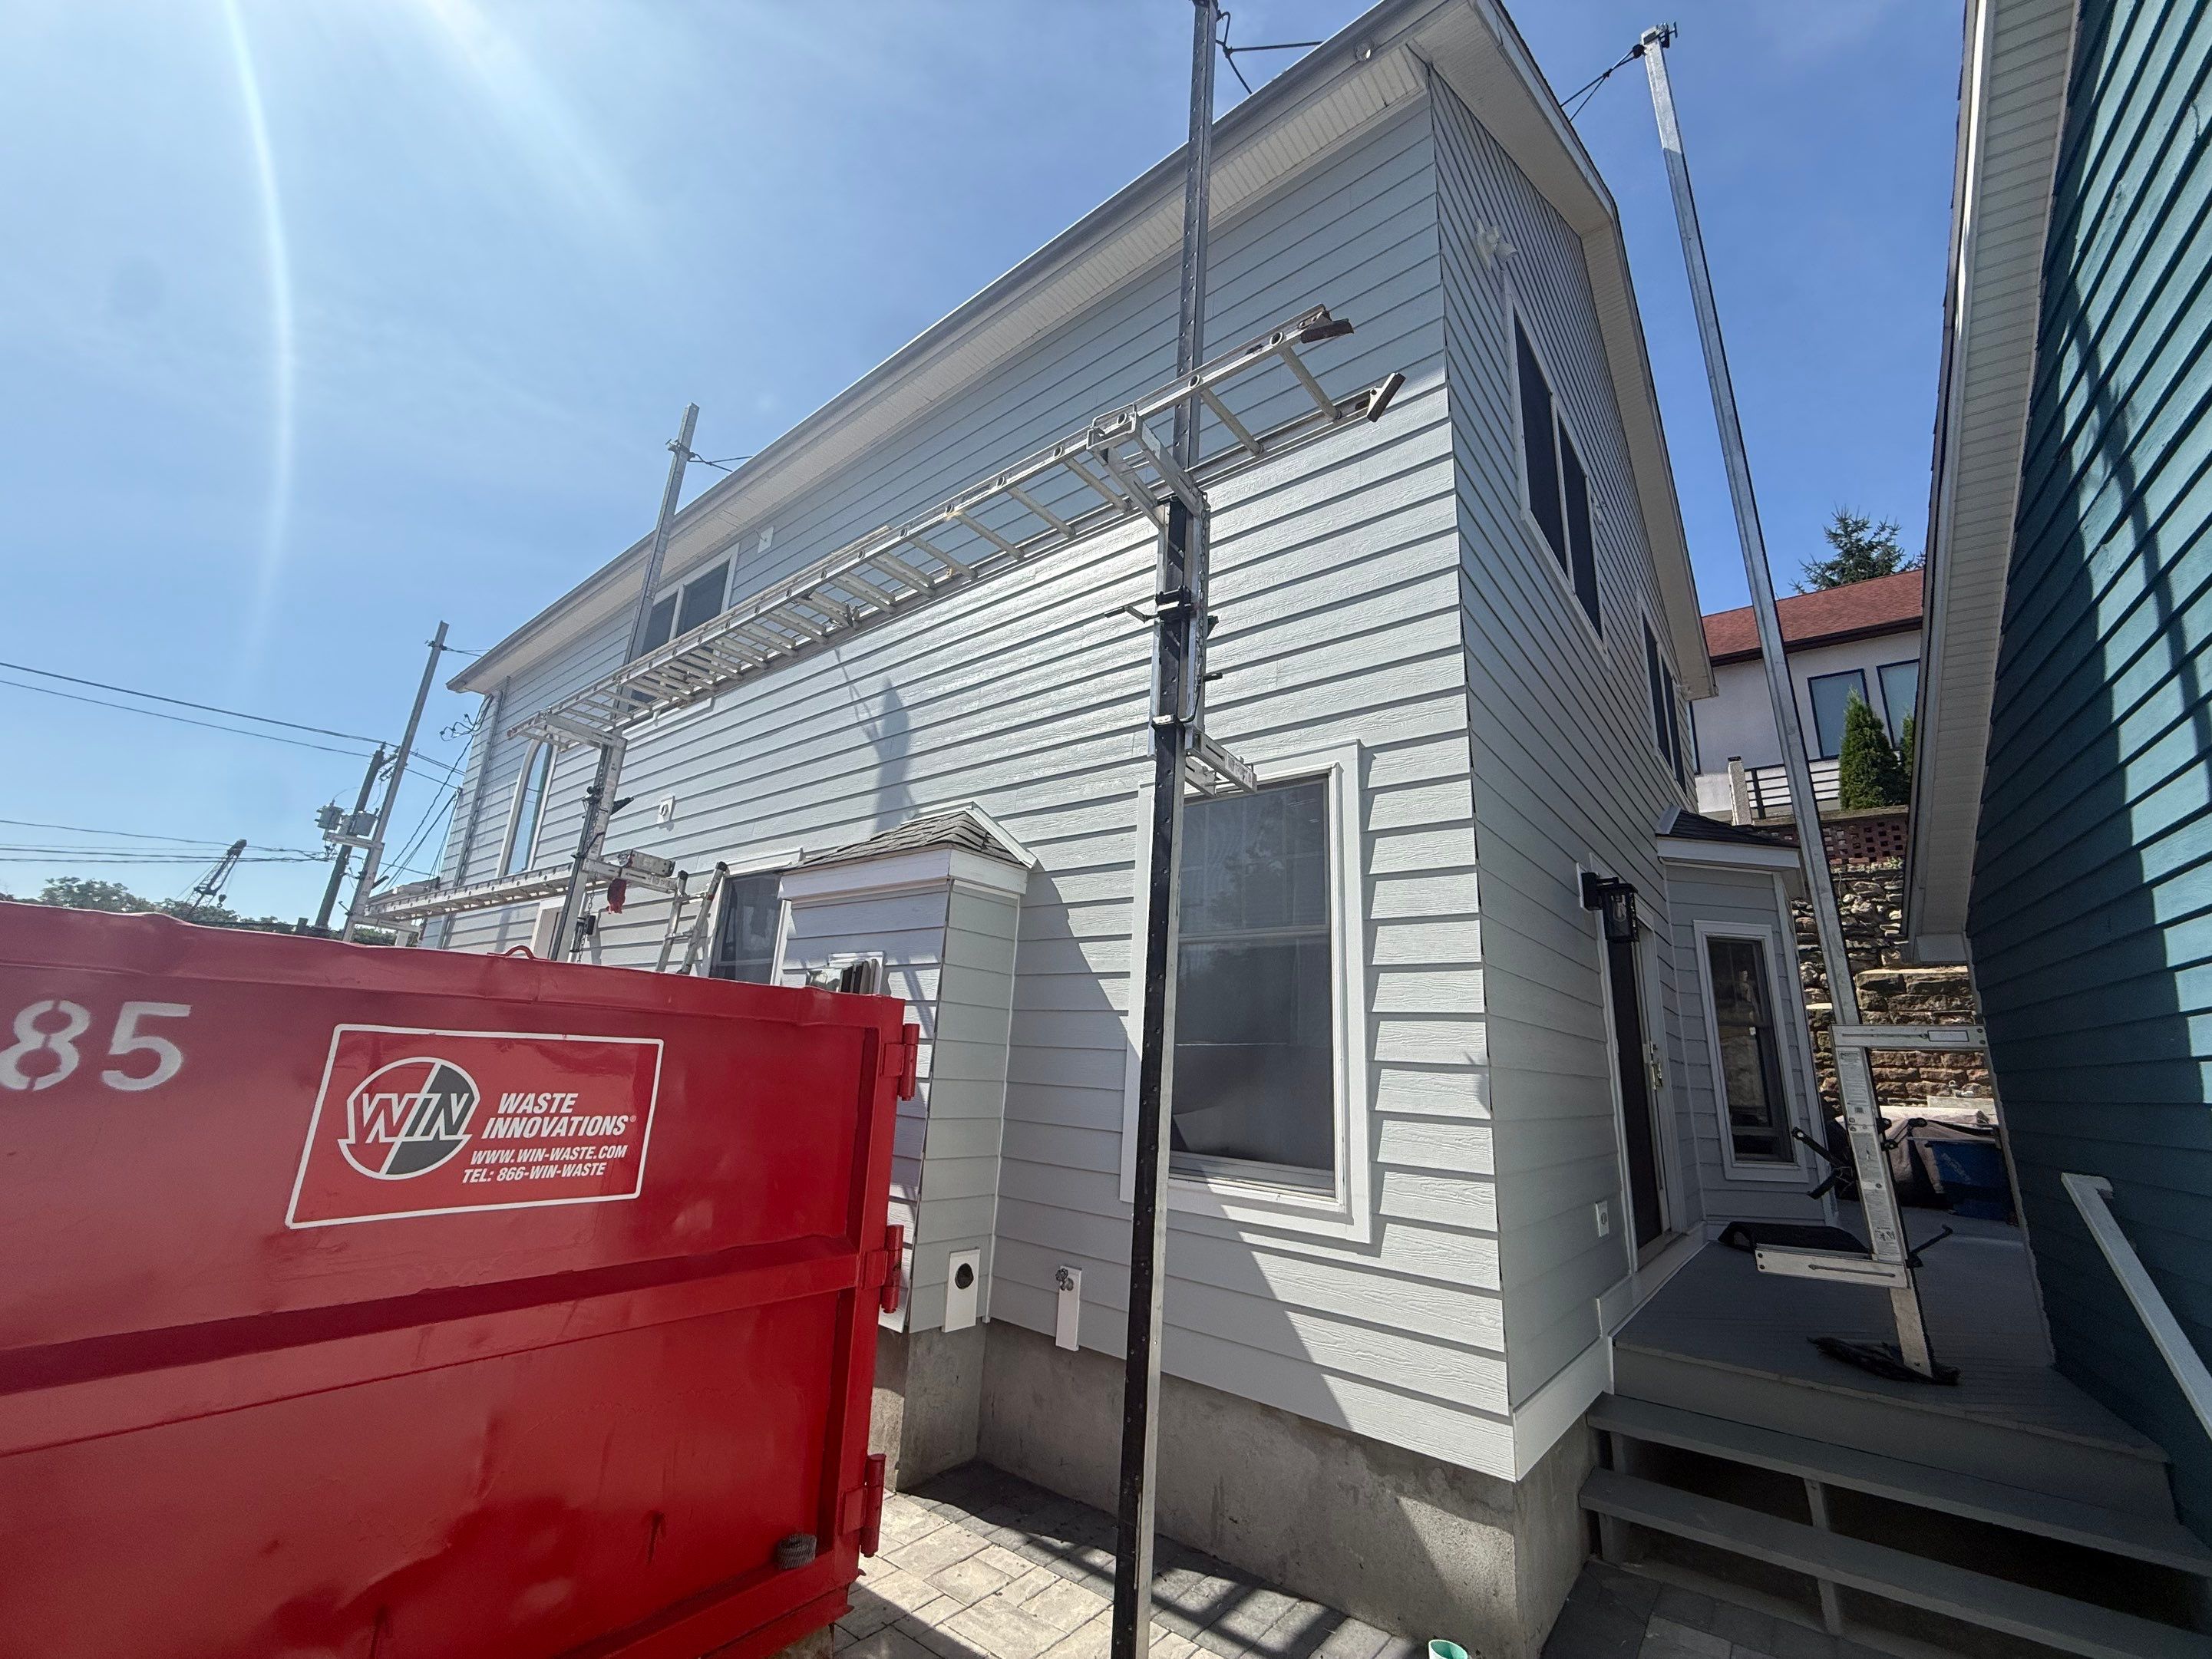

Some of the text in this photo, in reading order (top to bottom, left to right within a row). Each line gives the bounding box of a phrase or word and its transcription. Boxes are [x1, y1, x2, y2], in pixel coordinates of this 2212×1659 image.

[0, 999, 192, 1091] 85
[497, 1093, 578, 1114] WASTE
[362, 1093, 470, 1143] WIN
[470, 1145, 628, 1166] WWW.WIN-WASTE.COM
[462, 1163, 606, 1183] TEL: 866-WIN-WASTE
